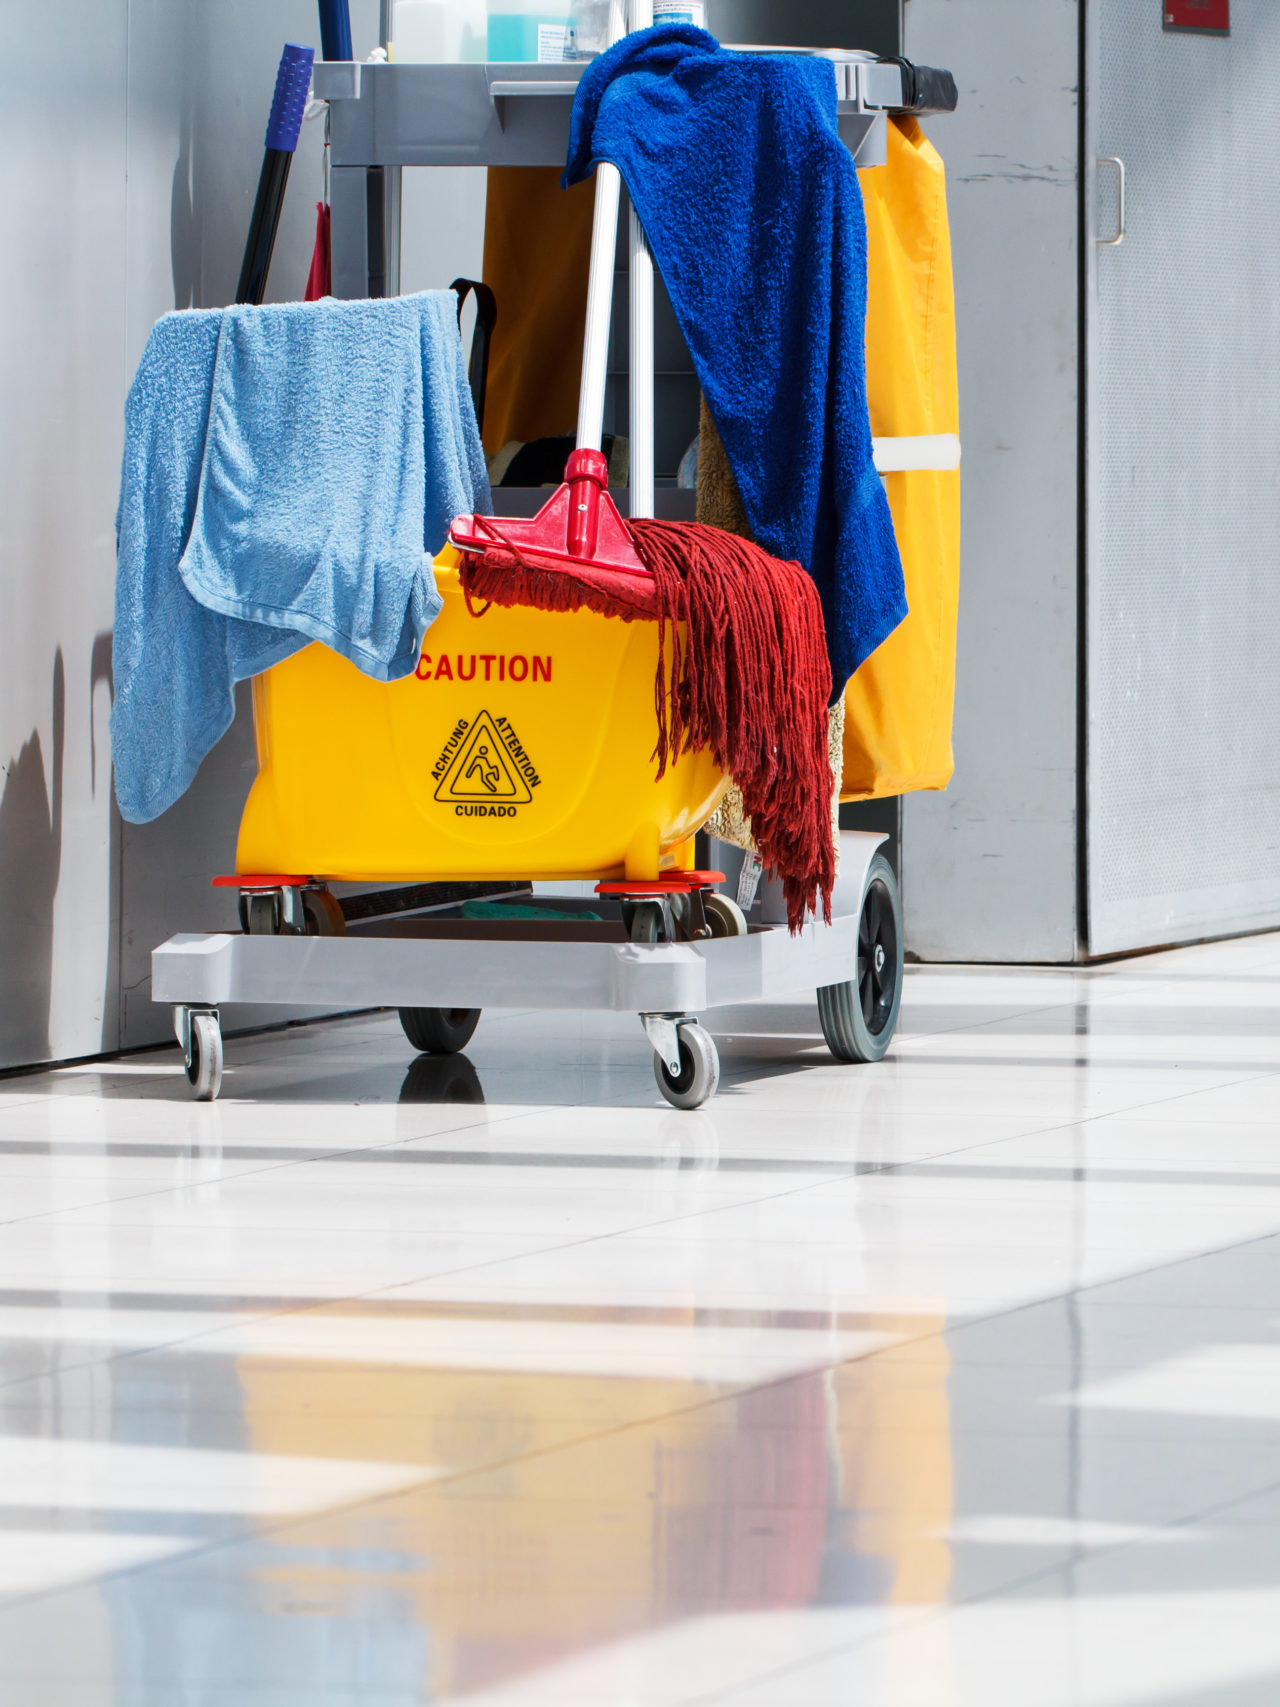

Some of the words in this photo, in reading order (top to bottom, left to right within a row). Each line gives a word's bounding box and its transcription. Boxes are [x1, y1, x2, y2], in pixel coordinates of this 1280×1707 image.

[415, 653, 552, 682] CAUTION
[430, 718, 469, 781] ACHTUNG
[495, 716, 542, 788] ATTENTION
[455, 805, 517, 818] CUIDADO
